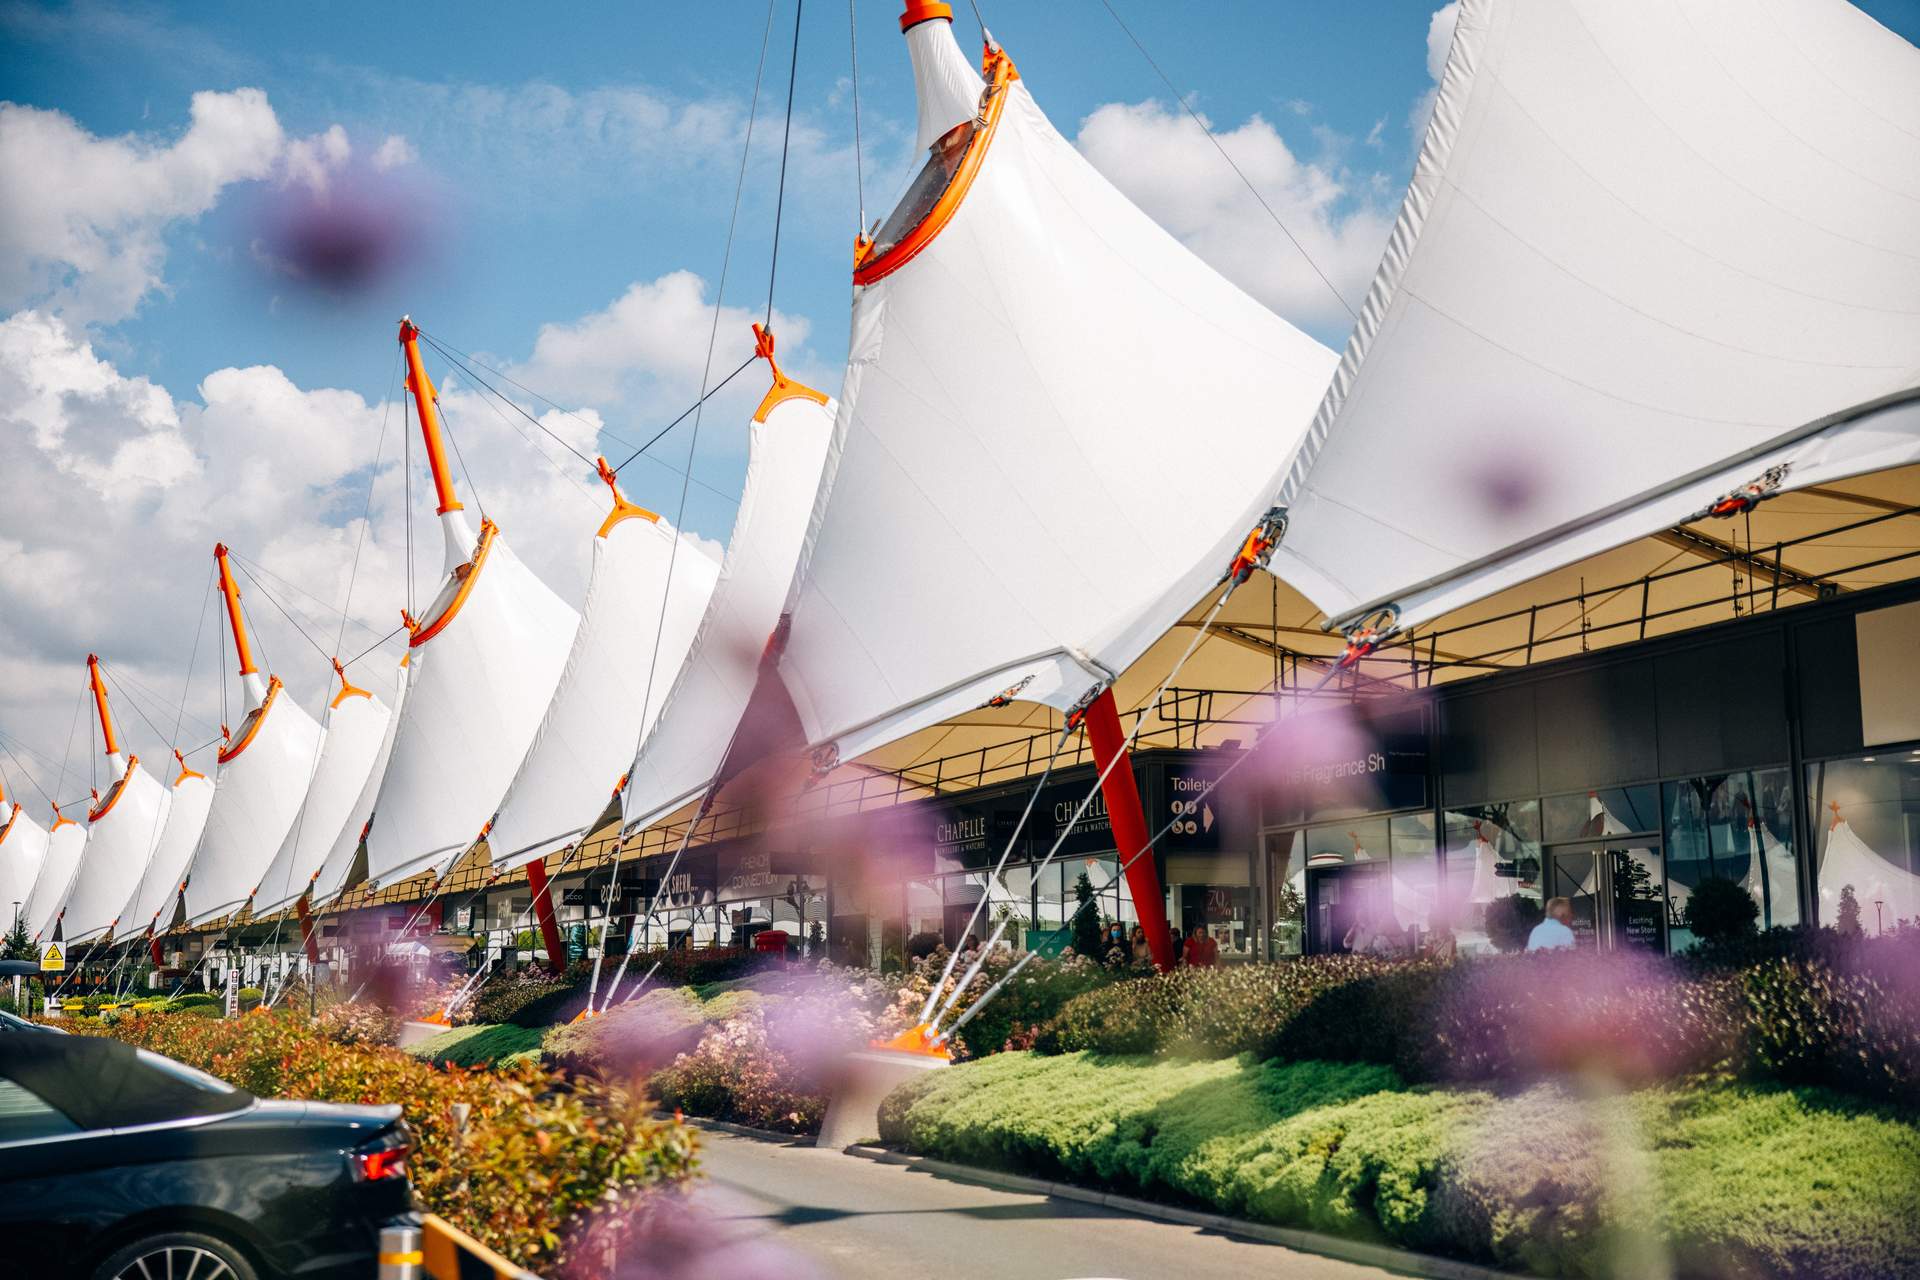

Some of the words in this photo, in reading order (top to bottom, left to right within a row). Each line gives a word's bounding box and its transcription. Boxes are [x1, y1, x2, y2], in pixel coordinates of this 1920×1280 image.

[1171, 777, 1215, 792] Toilets
[1303, 759, 1366, 785] Fragrance
[1054, 795, 1109, 823] CHAPELL
[937, 817, 985, 842] CHAPELLE
